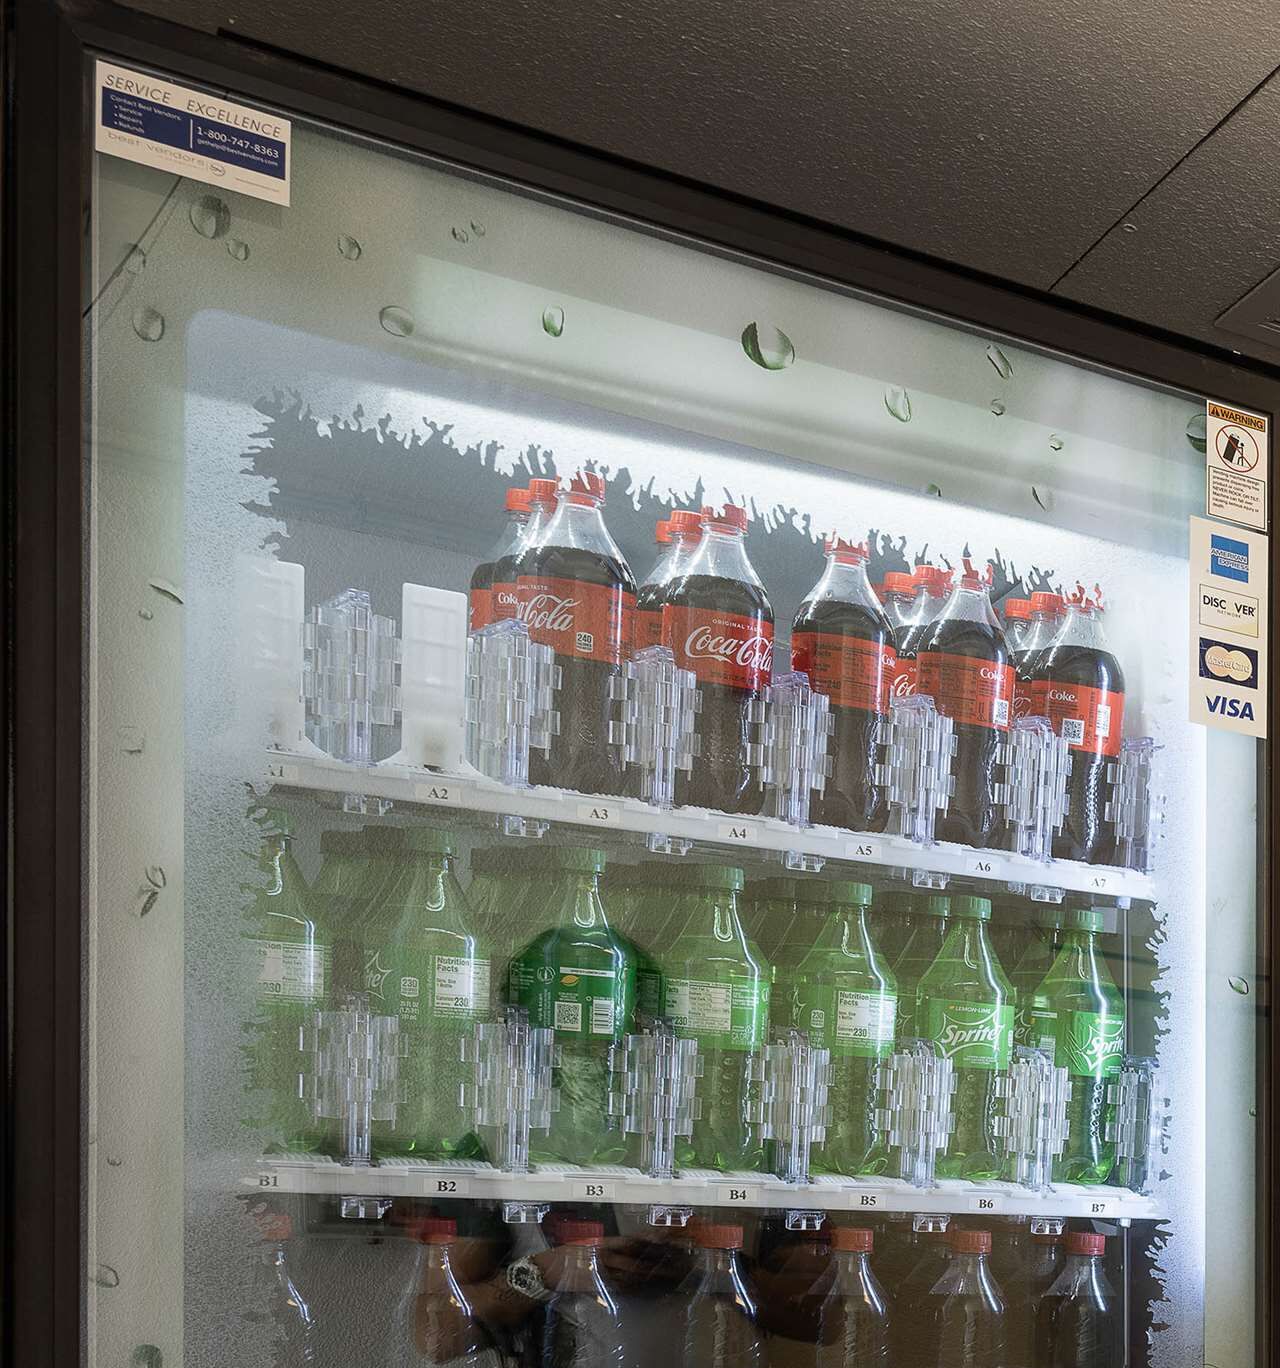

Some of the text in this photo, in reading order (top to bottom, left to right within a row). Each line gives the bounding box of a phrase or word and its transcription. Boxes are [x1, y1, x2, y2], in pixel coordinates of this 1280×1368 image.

[105, 74, 281, 138] SERVICE EXCELLENCE
[196, 126, 279, 159] 1-800-747-8363
[1220, 409, 1264, 431] WARNING
[576, 633, 593, 644] 240
[684, 625, 773, 673] Coca-Cola
[980, 666, 1006, 683] Coke
[1205, 694, 1255, 721] VISA
[427, 786, 449, 800] A2
[588, 809, 609, 821] A3
[727, 827, 747, 839] A4
[855, 844, 873, 856] A5
[974, 860, 992, 873] A6
[1090, 876, 1107, 888] A7
[436, 957, 470, 967] Nutrition
[401, 978, 418, 988] 230
[838, 991, 870, 1001] Nutrition
[454, 997, 469, 1008] 230
[852, 1027, 868, 1038] 230
[941, 1024, 1000, 1046] Sprite
[437, 1180, 457, 1193] B2
[586, 1184, 605, 1197] B3
[729, 1189, 747, 1200] B4
[860, 1195, 877, 1206] B5
[978, 1198, 994, 1209] B6
[1091, 1202, 1106, 1213] B7
